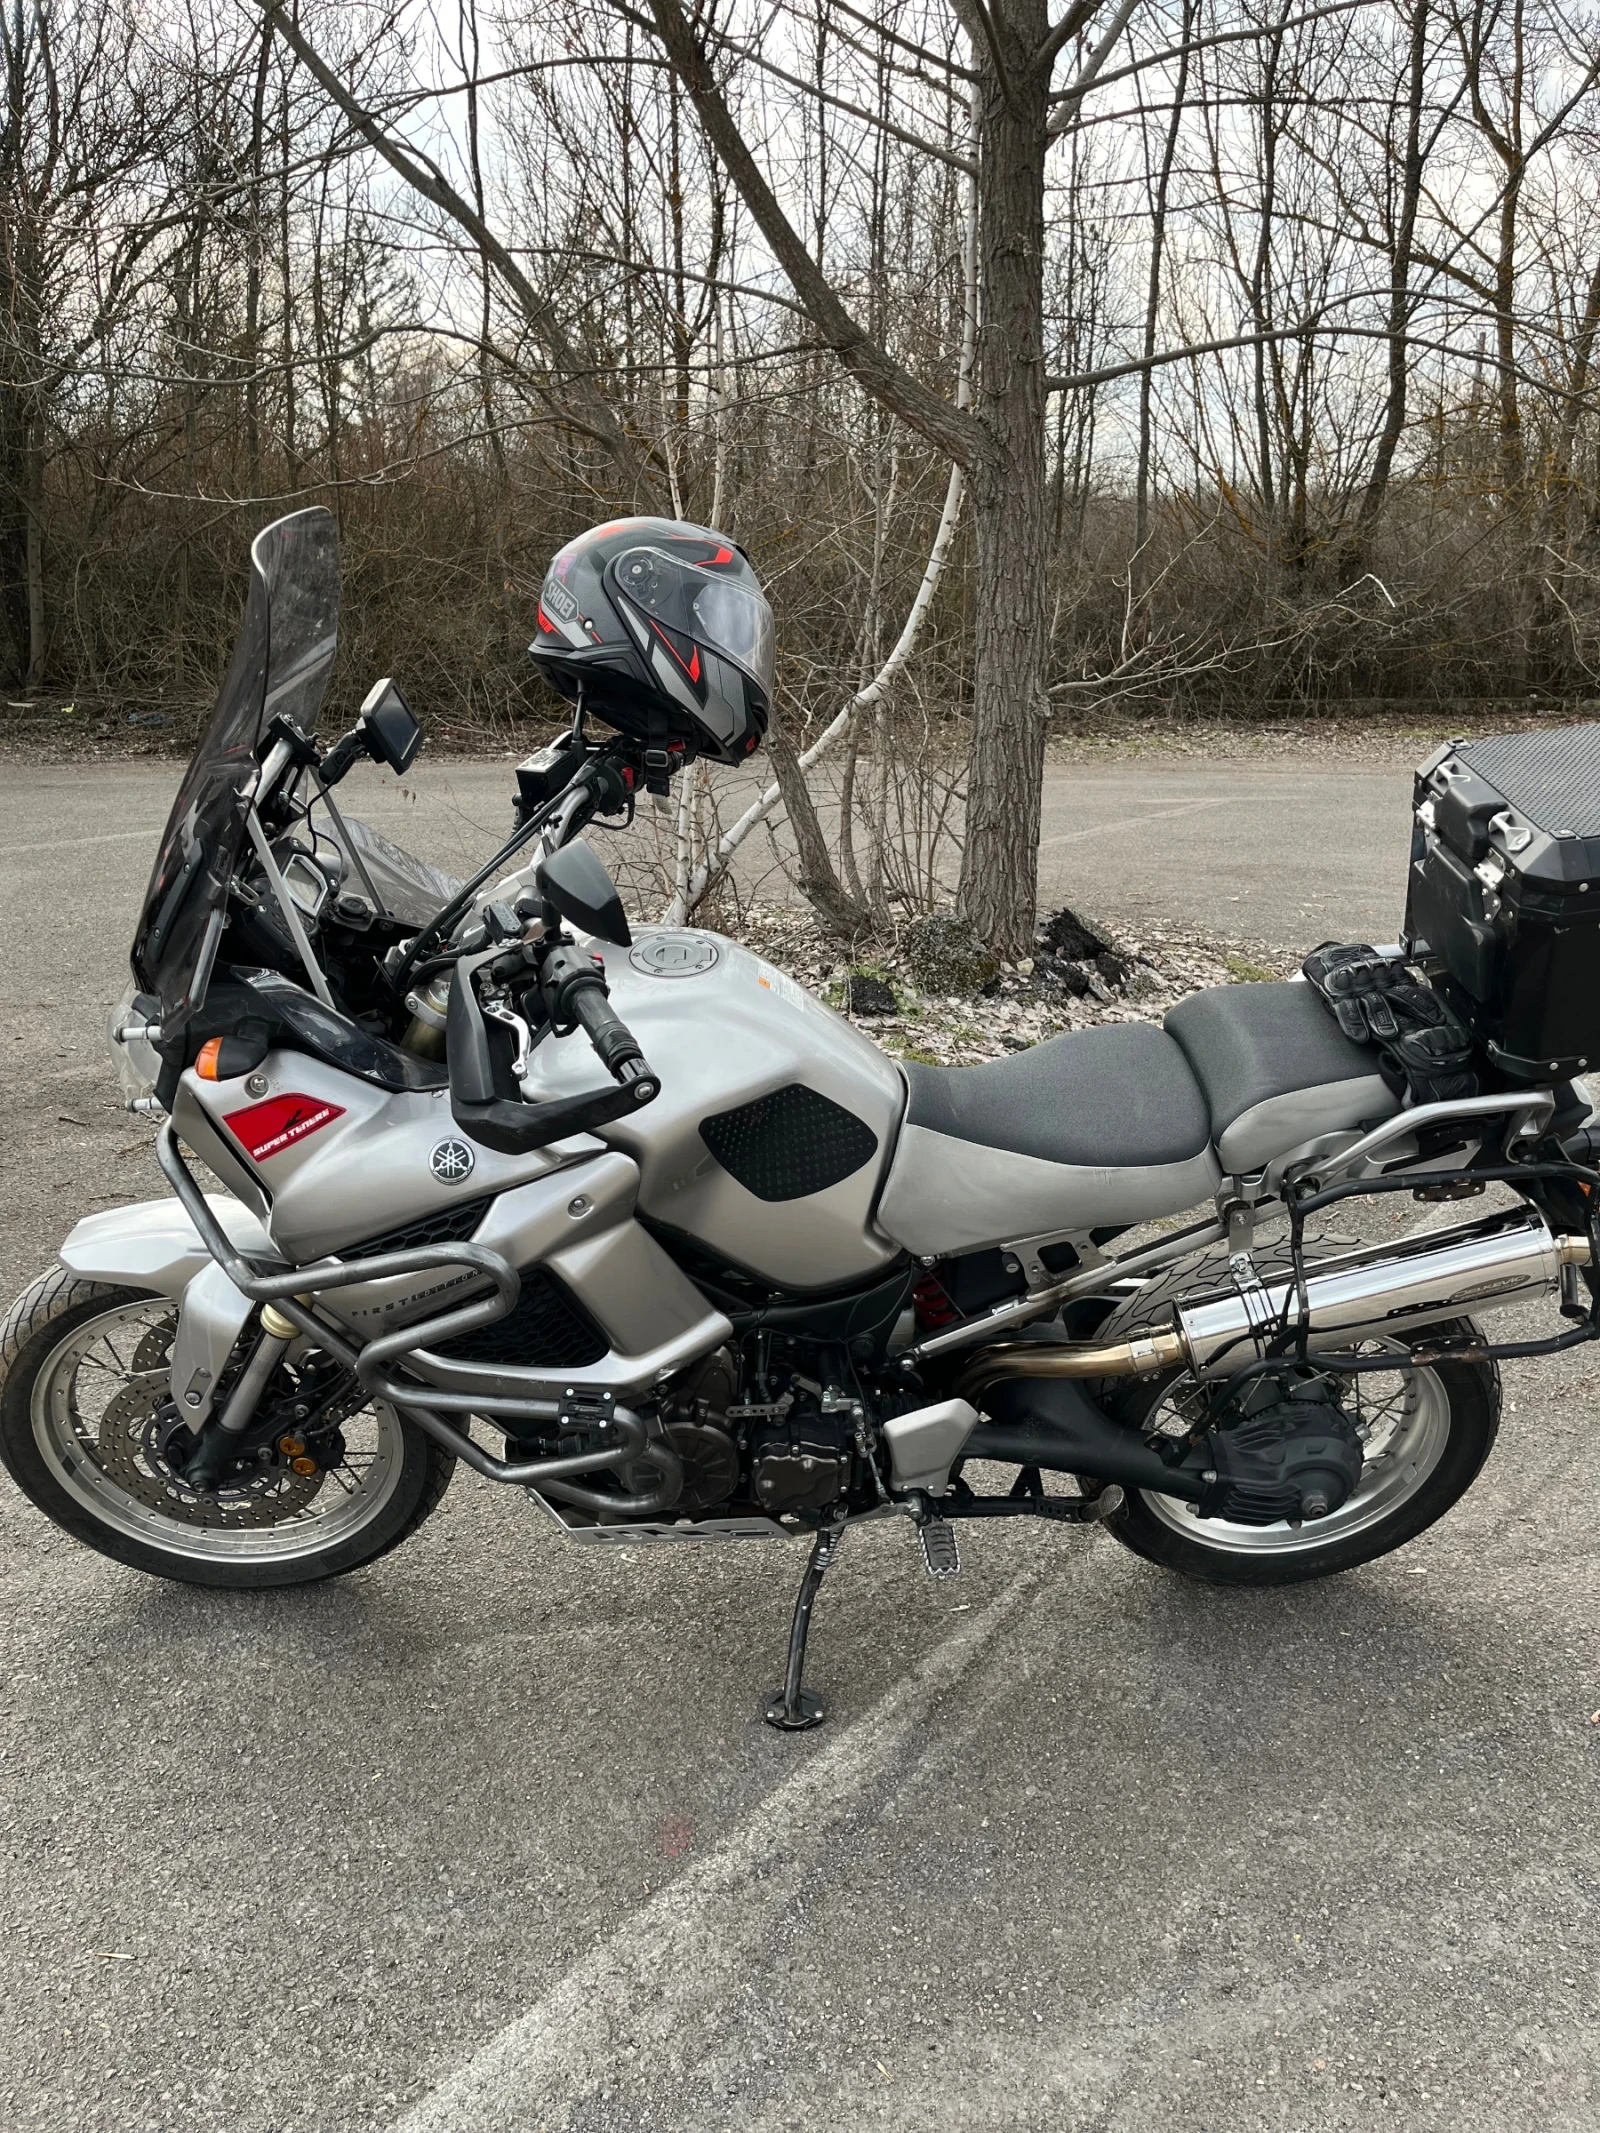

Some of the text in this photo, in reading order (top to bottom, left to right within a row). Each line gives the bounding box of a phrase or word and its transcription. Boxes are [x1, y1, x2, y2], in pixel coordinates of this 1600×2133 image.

[545, 581, 576, 619] SHOEI
[253, 1133, 289, 1157] SUPER
[352, 1269, 478, 1317] FIRST EDITION
